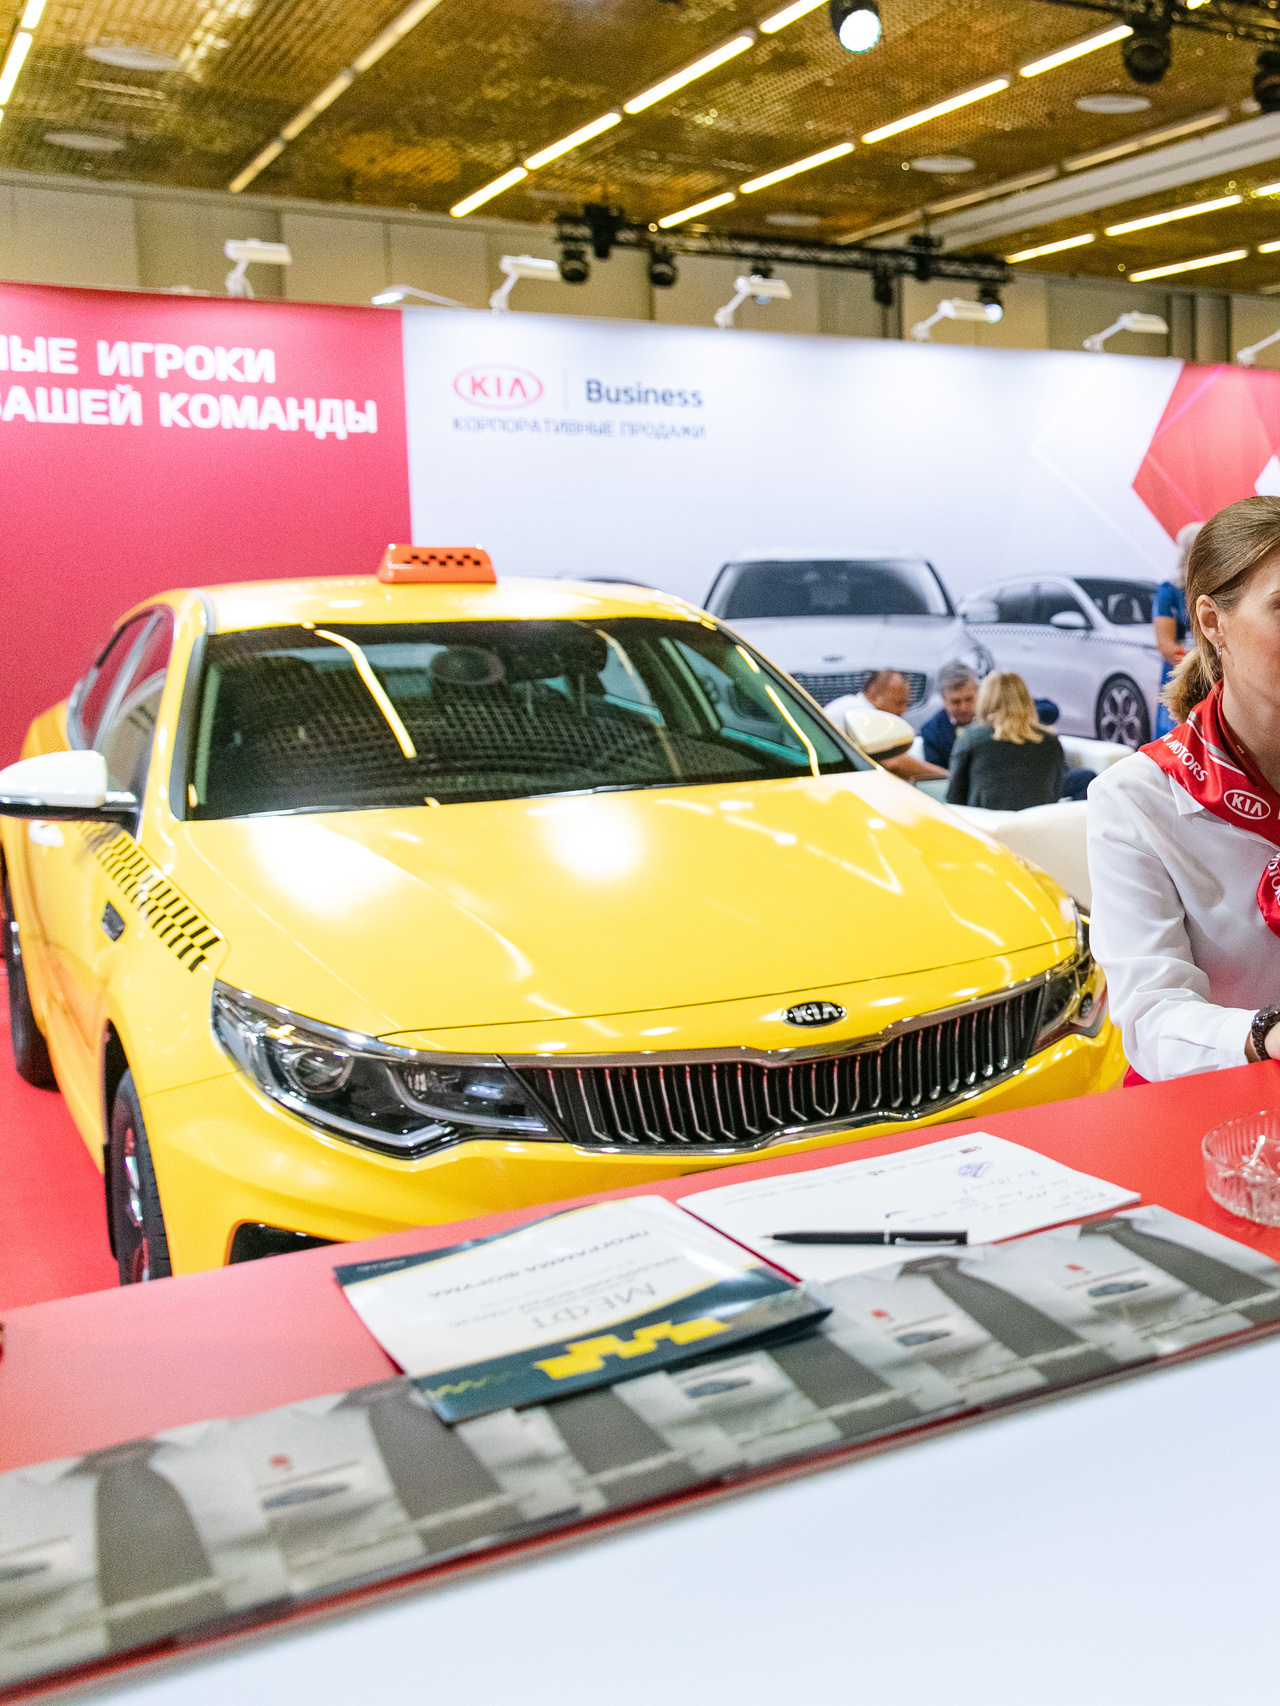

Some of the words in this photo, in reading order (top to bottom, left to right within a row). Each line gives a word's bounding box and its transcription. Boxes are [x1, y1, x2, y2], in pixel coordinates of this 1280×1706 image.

[97, 339, 276, 383] ИГРОКИ
[585, 378, 703, 408] Business
[158, 391, 378, 440] КОМАНДЫ
[1166, 739, 1209, 782] MOTORS
[1231, 793, 1262, 817] KIA
[791, 1001, 840, 1024] KIA
[531, 1280, 657, 1332] МЕФТ
